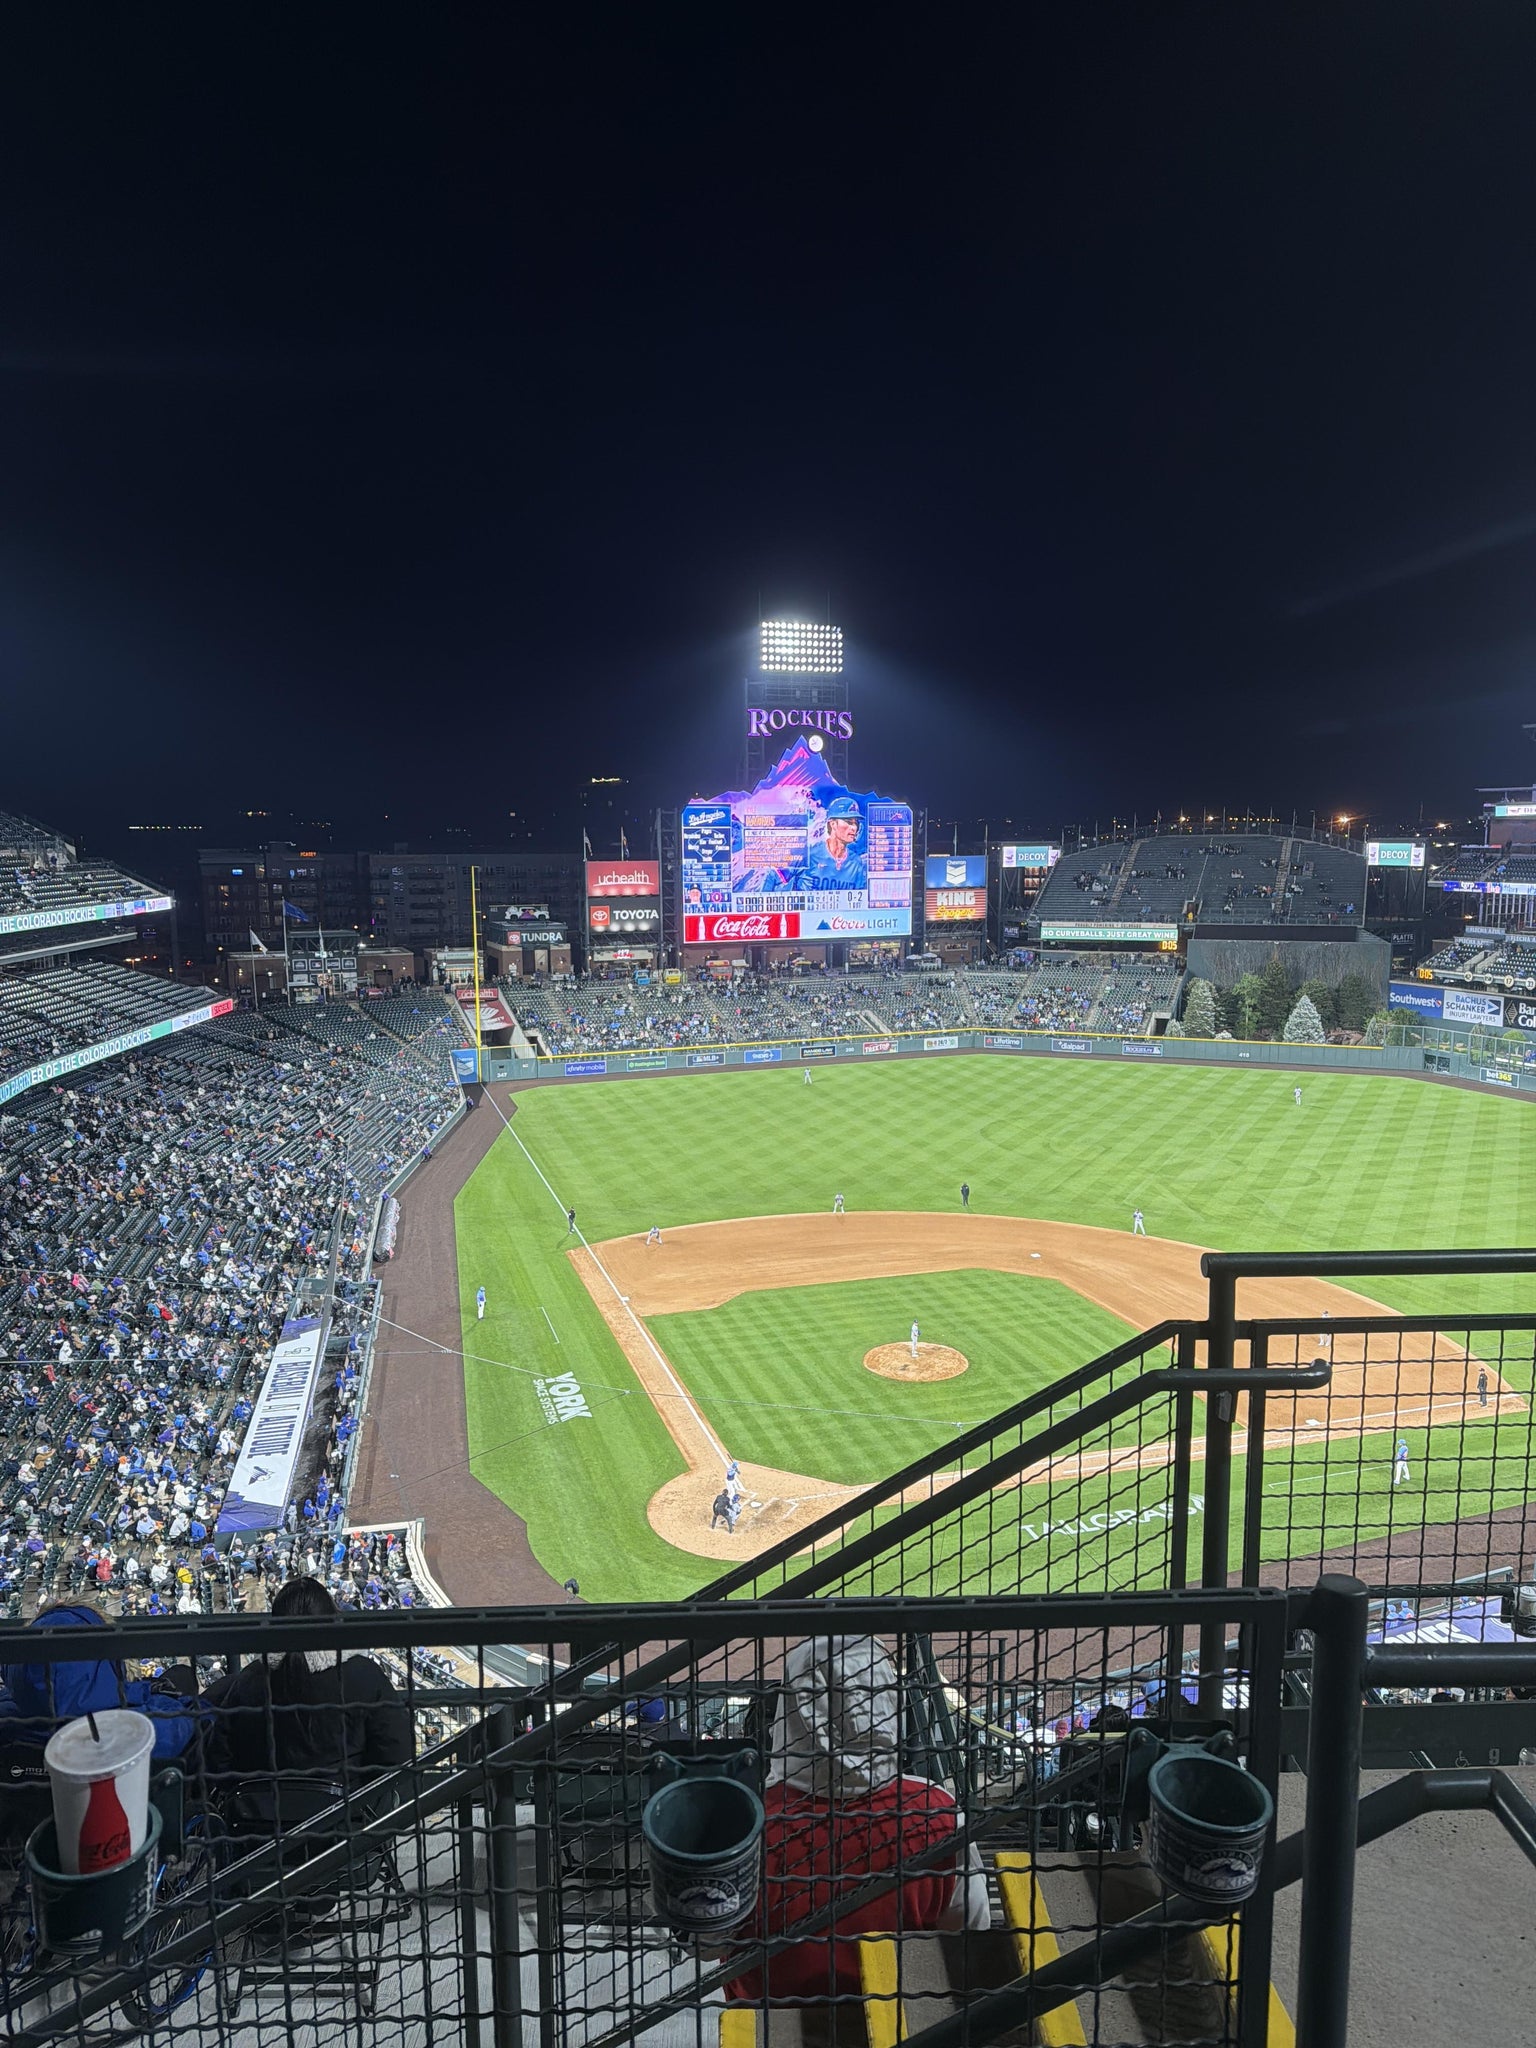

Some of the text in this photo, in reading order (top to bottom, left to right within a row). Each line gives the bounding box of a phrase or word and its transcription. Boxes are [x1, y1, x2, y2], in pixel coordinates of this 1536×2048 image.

[747, 708, 854, 740] ROCKIES
[1018, 853, 1046, 861] DECOY
[1381, 850, 1409, 859] DECOY
[598, 870, 649, 885] uchealth
[936, 892, 975, 906] KING
[16, 912, 63, 929] COLORADO
[65, 907, 97, 923] ROCKIES
[613, 909, 659, 920] TOYOTA
[713, 915, 771, 938] Coca-Cola
[831, 916, 898, 930] Coors LIGHT
[521, 932, 563, 942] TUNDRA
[461, 989, 494, 998] uchalth
[1390, 992, 1435, 1008] Southwest
[1455, 995, 1487, 1005] BACHUS
[1445, 1001, 1486, 1013] SCHANKER
[1449, 1011, 1496, 1022] INJURY LAWYERS
[1518, 1015, 1536, 1028] Col
[1061, 1041, 1084, 1051] dialpad
[11, 1067, 43, 1096] PARTNER
[46, 1063, 59, 1078] OF
[59, 1055, 77, 1073] THE
[78, 1039, 121, 1064] COLORADO
[121, 1029, 151, 1049] ROCKIES
[567, 1063, 605, 1073] xfinity mobile
[1486, 1070, 1512, 1081] bet365
[265, 1360, 312, 1402] BASEBALL
[533, 1379, 559, 1424] SPACE SYSTEMS
[545, 1371, 593, 1422] YORK
[262, 1403, 301, 1413] AT
[247, 1415, 298, 1459] ALTITUDE
[1488, 1747, 1500, 1765] 9
